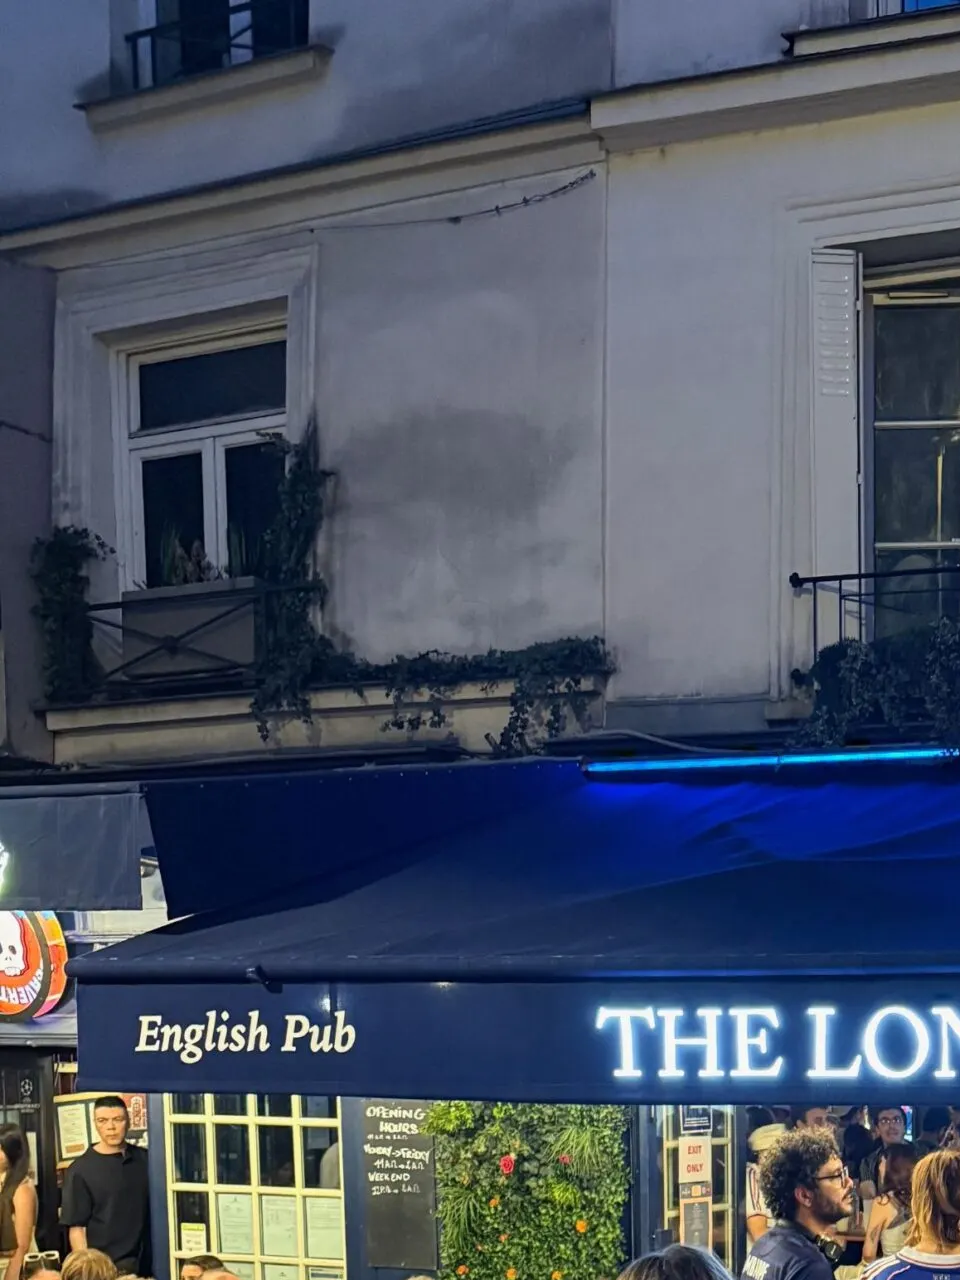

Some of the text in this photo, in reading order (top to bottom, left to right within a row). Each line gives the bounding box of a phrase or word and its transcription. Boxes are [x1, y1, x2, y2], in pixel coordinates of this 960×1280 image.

[135, 1009, 356, 1064] English Pub
[596, 1006, 783, 1078] THE
[379, 1121, 419, 1134] HOURS
[687, 1145, 702, 1155] EXIT
[686, 1163, 704, 1173] ONLY
